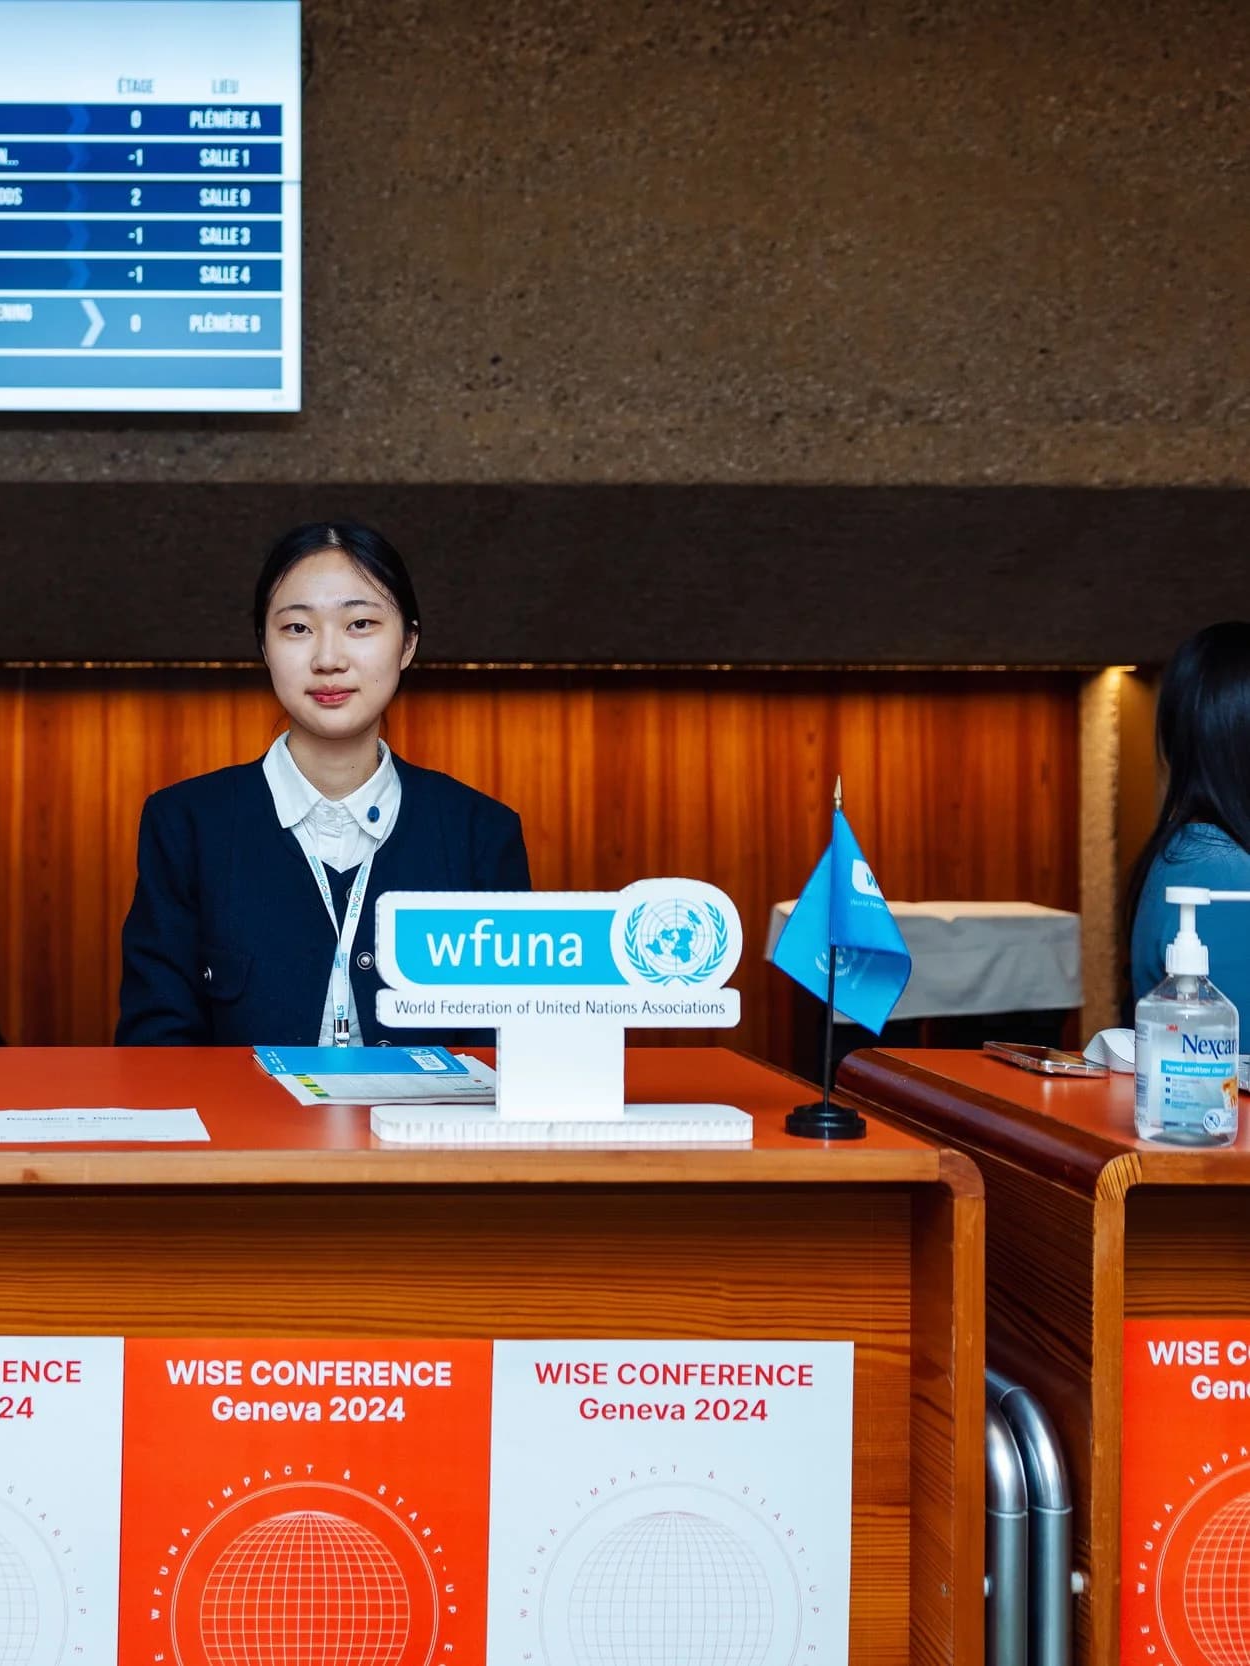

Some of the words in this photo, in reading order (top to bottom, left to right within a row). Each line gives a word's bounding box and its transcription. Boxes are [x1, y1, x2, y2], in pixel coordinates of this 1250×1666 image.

[212, 78, 239, 95] LIEU
[199, 149, 240, 167] SALLE
[199, 188, 240, 206] SALLE
[199, 227, 240, 245] SALLE
[199, 266, 240, 284] SALLE
[426, 919, 584, 967] wfuna
[394, 1000, 436, 1014] World
[440, 1000, 513, 1014] Federation
[517, 1000, 531, 1014] of
[536, 1000, 581, 1014] United
[586, 1000, 637, 1014] Nations
[641, 1000, 726, 1014] Associations
[1147, 1340, 1219, 1366] WISE
[1226, 1340, 1250, 1366] C
[165, 1359, 243, 1386] WISE
[250, 1360, 452, 1387] CONFERENCE
[535, 1362, 608, 1385] WISE
[617, 1363, 814, 1387] CONFERENCE
[1191, 1375, 1250, 1400] Gen
[211, 1395, 322, 1421] Geneva
[329, 1396, 406, 1422] 2024
[578, 1398, 686, 1421] Geneva
[694, 1398, 768, 1422] 2024
[150, 1526, 191, 1621] WFUNA
[207, 1463, 315, 1509] IMPACT
[1137, 1502, 1174, 1594] WFUNA
